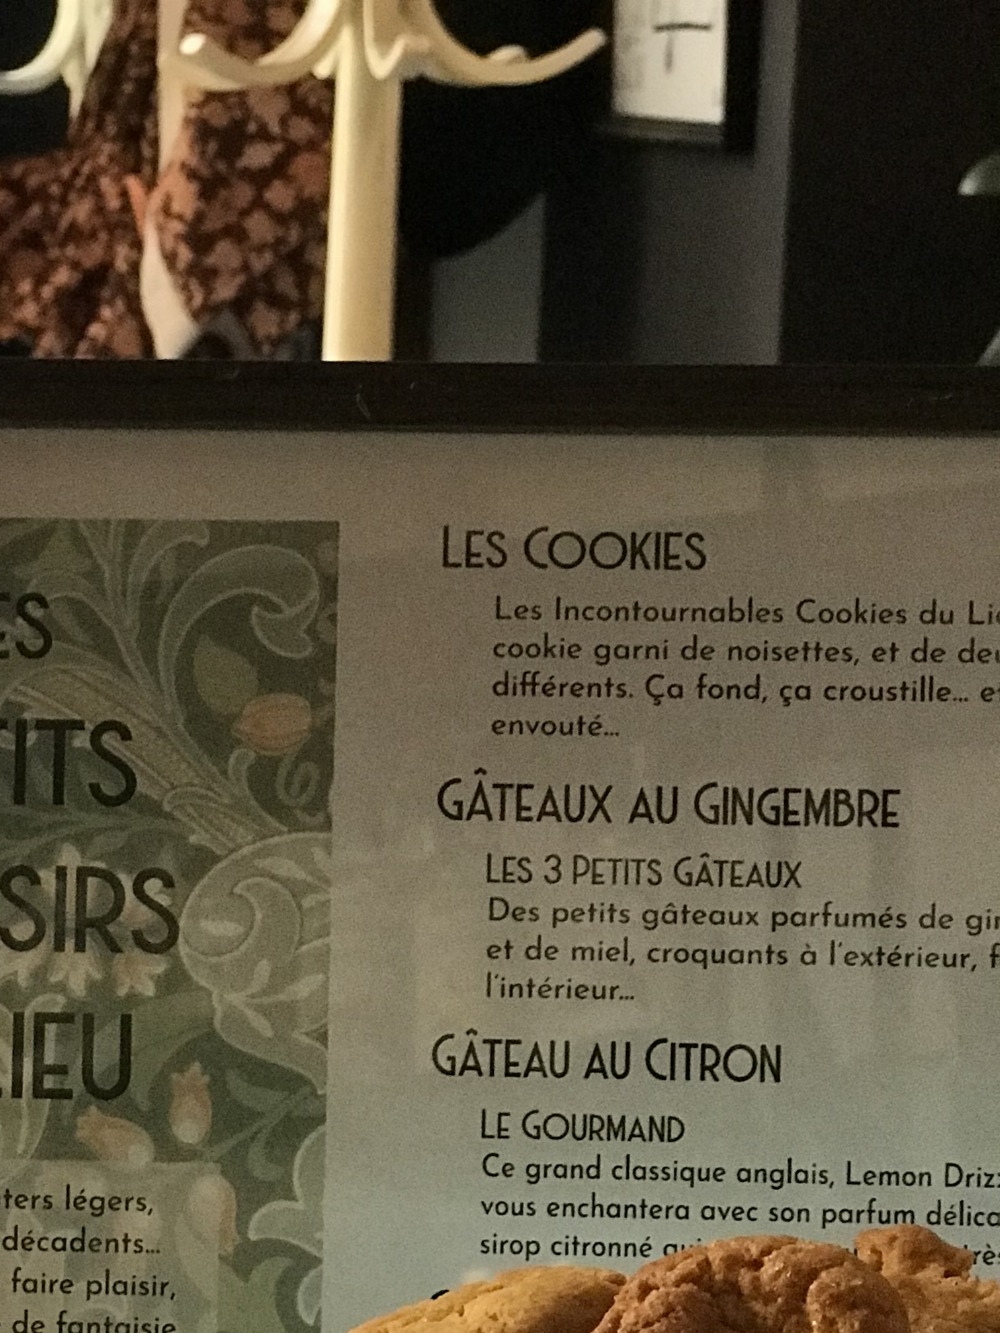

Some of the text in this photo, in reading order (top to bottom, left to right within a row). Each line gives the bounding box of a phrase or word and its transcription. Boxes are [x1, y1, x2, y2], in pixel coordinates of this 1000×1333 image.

[443, 526, 706, 570] LES COOKIES
[496, 595, 542, 620] Les
[556, 596, 783, 623] Incontournables
[796, 598, 907, 624] Cookies
[919, 599, 953, 624] du
[493, 632, 582, 659] cookie
[594, 640, 668, 666] garni
[681, 634, 715, 660] de
[728, 640, 859, 665] noisettes,
[872, 642, 899, 662] et
[911, 637, 946, 663] de
[492, 671, 1000, 707] différents. Ça fond, ça croustille... e
[492, 715, 619, 736] envouté...
[438, 767, 900, 828] GÂTEAUX AU GINGEMBRE
[487, 853, 801, 888] LES 3 PETITS GÂTEAUX
[489, 897, 539, 922] Des
[552, 903, 630, 928] petits
[642, 903, 758, 931] gâteaux
[771, 901, 907, 932] parfumés
[919, 903, 953, 929] de
[487, 940, 513, 959] et
[525, 935, 558, 960] de
[572, 937, 635, 966] miel,
[647, 945, 788, 969] croquants
[800, 944, 816, 965] à
[830, 940, 976, 972] l'extérieur,
[487, 972, 634, 1000] l'intérieur...
[432, 1028, 781, 1083] GÂTEAU AU CITRON
[481, 1109, 685, 1142] LE GOURMAND
[482, 1153, 514, 1178] Ce
[526, 1154, 600, 1184] grand
[612, 1154, 726, 1188] classique
[737, 1158, 834, 1190] anglais,
[846, 1161, 931, 1186] Lemon
[66, 1184, 152, 1217] légers,
[481, 1201, 536, 1216] vous
[547, 1192, 689, 1220] enchantera
[701, 1205, 757, 1221] avec
[769, 1207, 809, 1222] son
[822, 1198, 915, 1229] parfum
[2, 1225, 160, 1253] décadents...
[481, 1233, 540, 1261] sirop
[551, 1235, 652, 1258] citronné
[12, 1267, 74, 1294] faire
[87, 1269, 175, 1300] plaisir,
